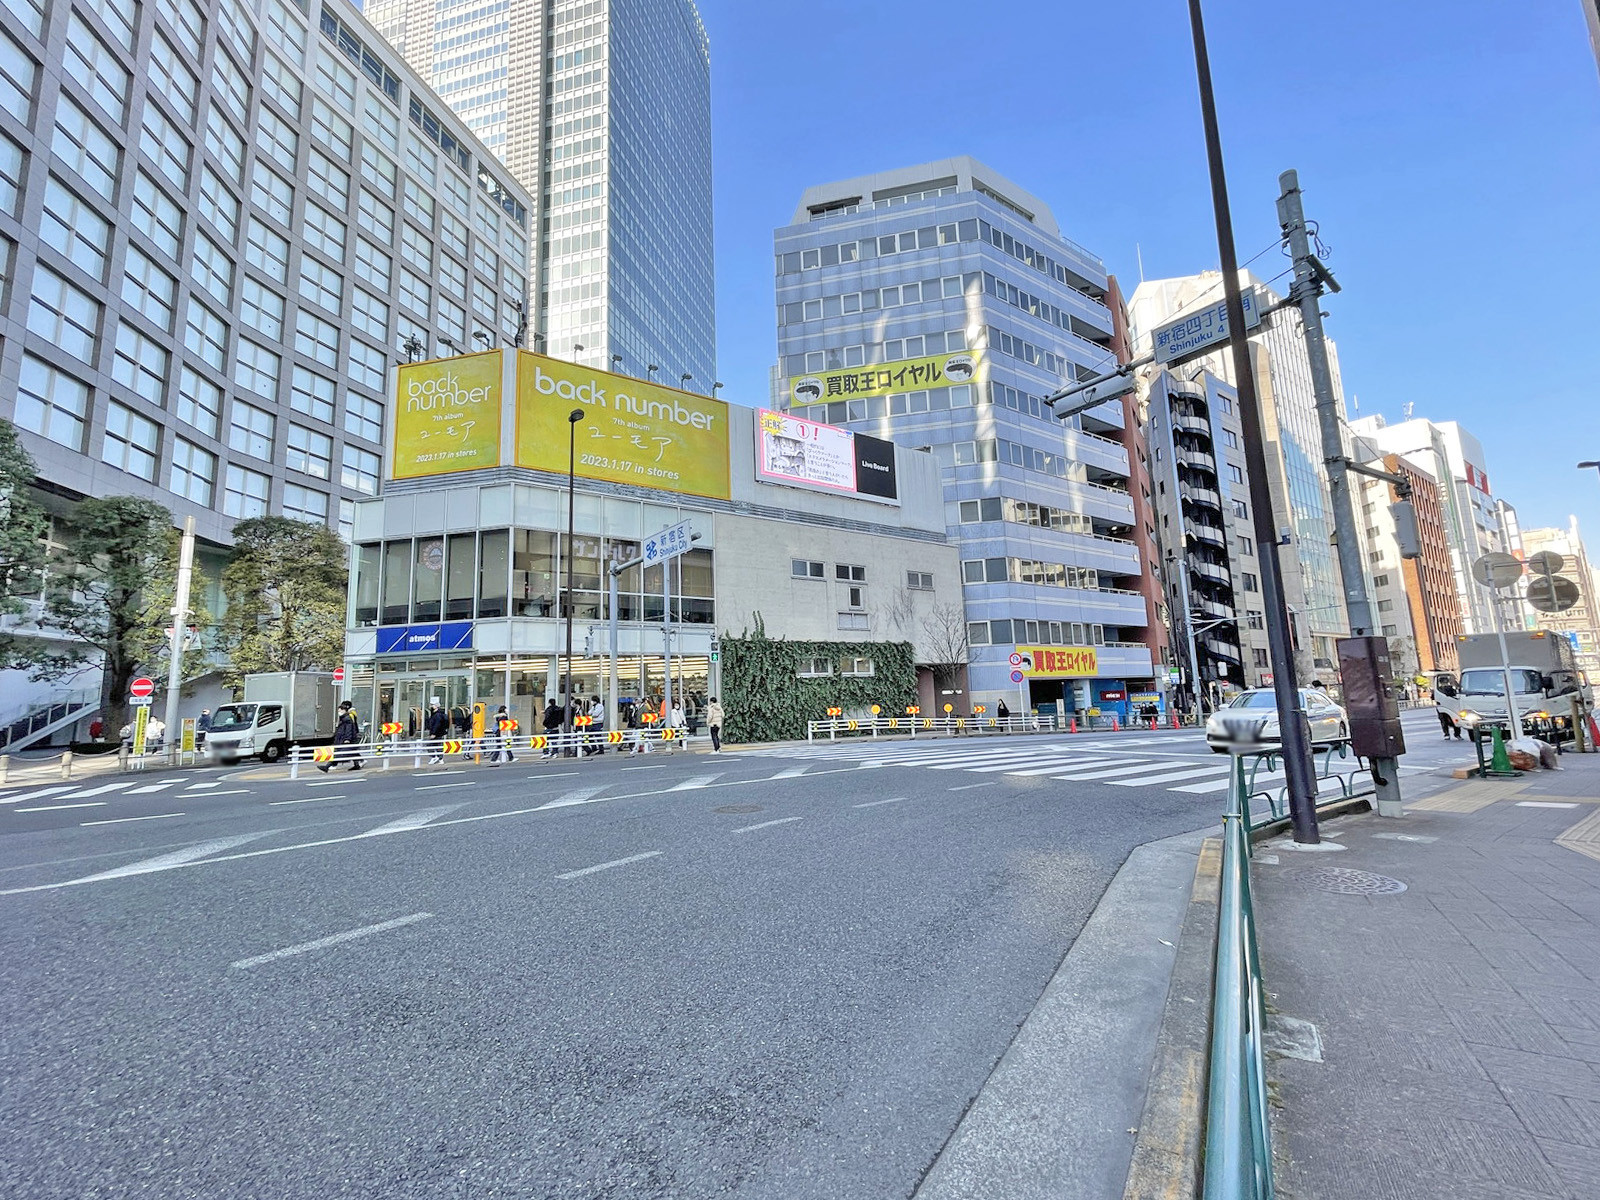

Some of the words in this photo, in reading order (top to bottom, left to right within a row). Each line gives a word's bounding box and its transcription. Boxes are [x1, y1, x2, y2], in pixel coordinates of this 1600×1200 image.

[1170, 332, 1213, 354] Shinjuku
[1217, 325, 1225, 334] 4
[408, 371, 458, 397] back
[826, 362, 942, 397] 買取王ロイヤル
[407, 385, 492, 412] number
[535, 366, 607, 408] back
[615, 393, 715, 431] number
[432, 414, 443, 422] 7th
[444, 412, 464, 420] album
[612, 417, 626, 427] 7th
[627, 420, 650, 431] album
[416, 452, 447, 463] 2023.1.17
[456, 448, 477, 457] stores
[588, 426, 672, 462] ユーモア
[580, 453, 632, 471] 2023.1.17
[634, 464, 644, 474] in
[647, 466, 680, 480] stores
[861, 460, 873, 469] Live
[873, 462, 890, 472] Board
[660, 526, 685, 546] 新宿区
[409, 634, 436, 643] atmos
[1033, 650, 1096, 673] 買取王ロイヤル
